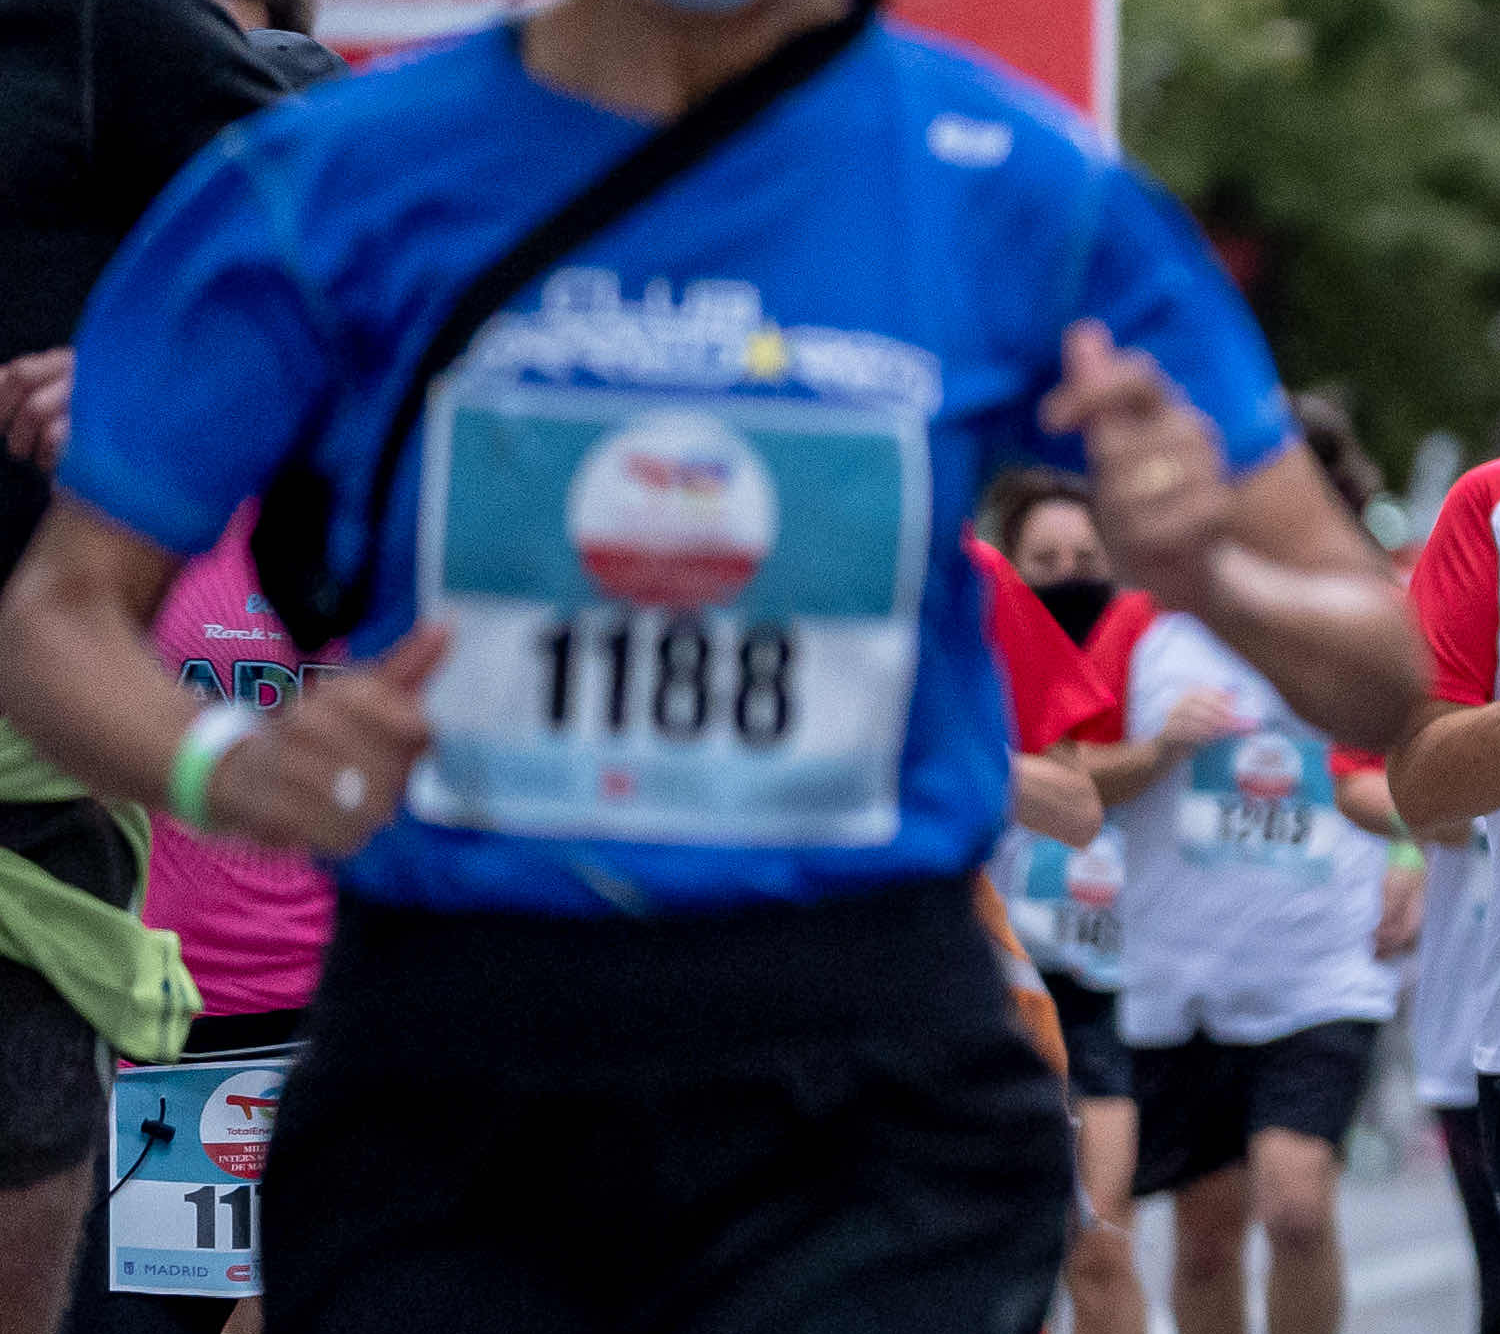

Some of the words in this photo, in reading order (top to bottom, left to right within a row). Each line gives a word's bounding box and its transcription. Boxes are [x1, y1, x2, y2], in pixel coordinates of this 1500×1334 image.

[542, 619, 794, 742] 1188
[184, 1185, 262, 1249] 11
[144, 1264, 209, 1278] MADRID
